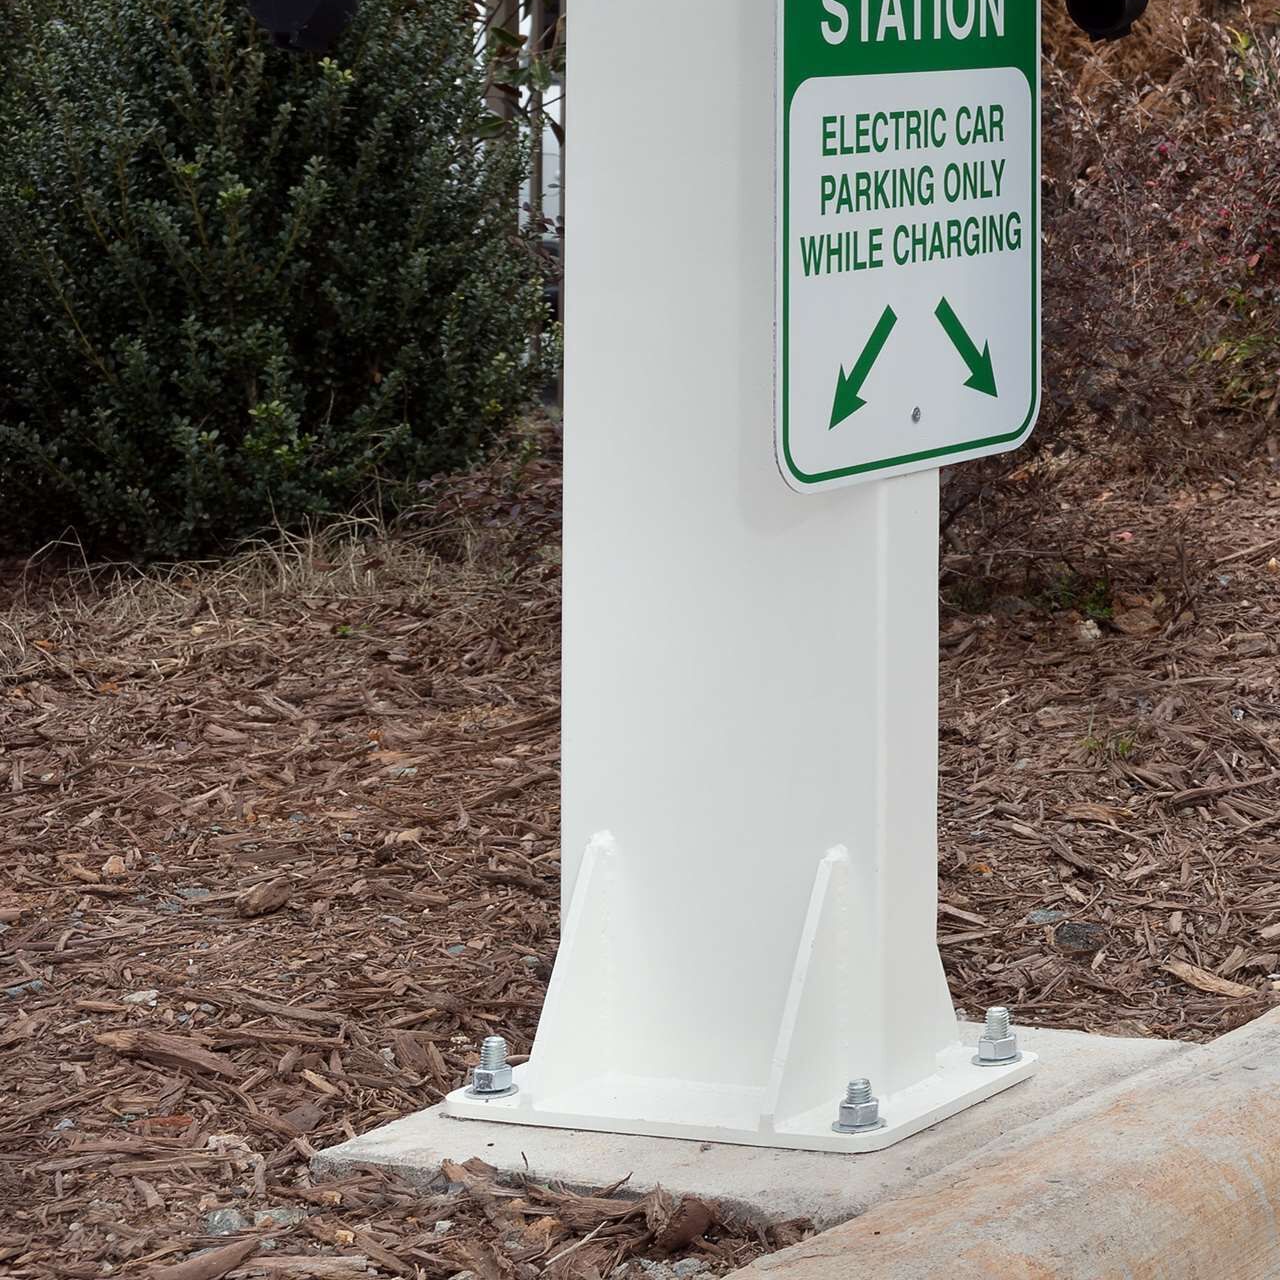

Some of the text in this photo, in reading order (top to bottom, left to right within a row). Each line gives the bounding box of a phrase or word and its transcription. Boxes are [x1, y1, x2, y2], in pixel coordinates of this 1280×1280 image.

[822, 104, 1005, 157] ELECTRIC CAR
[820, 159, 1006, 216] PARKING ONLY
[800, 211, 1022, 277] WHILE CHARGING
